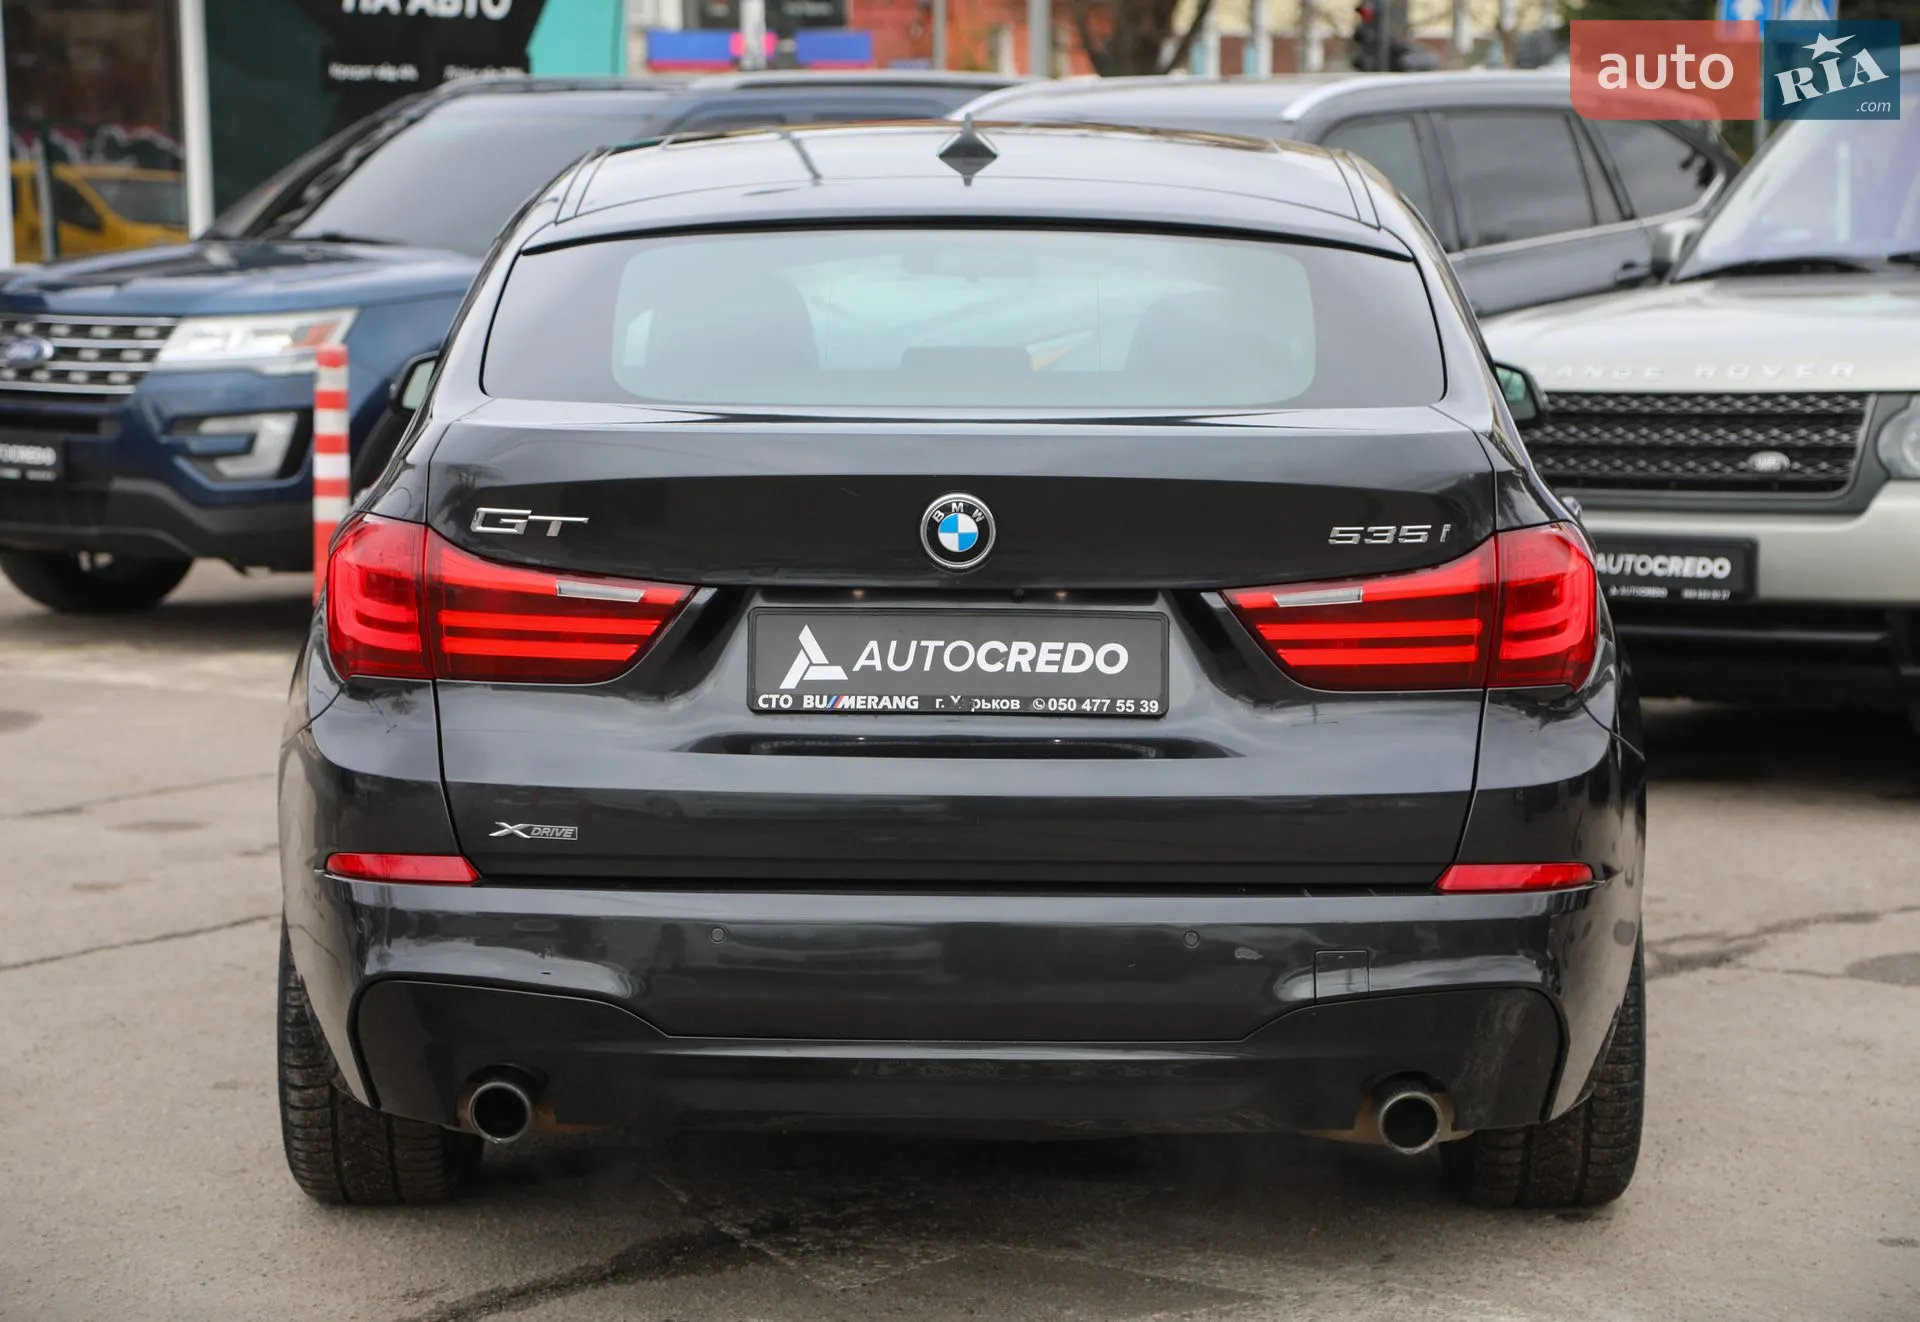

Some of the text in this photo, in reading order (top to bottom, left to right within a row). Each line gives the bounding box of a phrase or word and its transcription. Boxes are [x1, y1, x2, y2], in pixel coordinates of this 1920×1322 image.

[470, 507, 589, 537] GT
[931, 502, 985, 523] BMW
[1596, 552, 1732, 579] AUTOCREDO
[852, 640, 1129, 675] AUTOCREDO
[935, 698, 945, 709] г.
[1048, 698, 1077, 712] 050
[1081, 699, 1111, 712] 477
[1115, 699, 1136, 713] 55
[1139, 699, 1160, 713] 39
